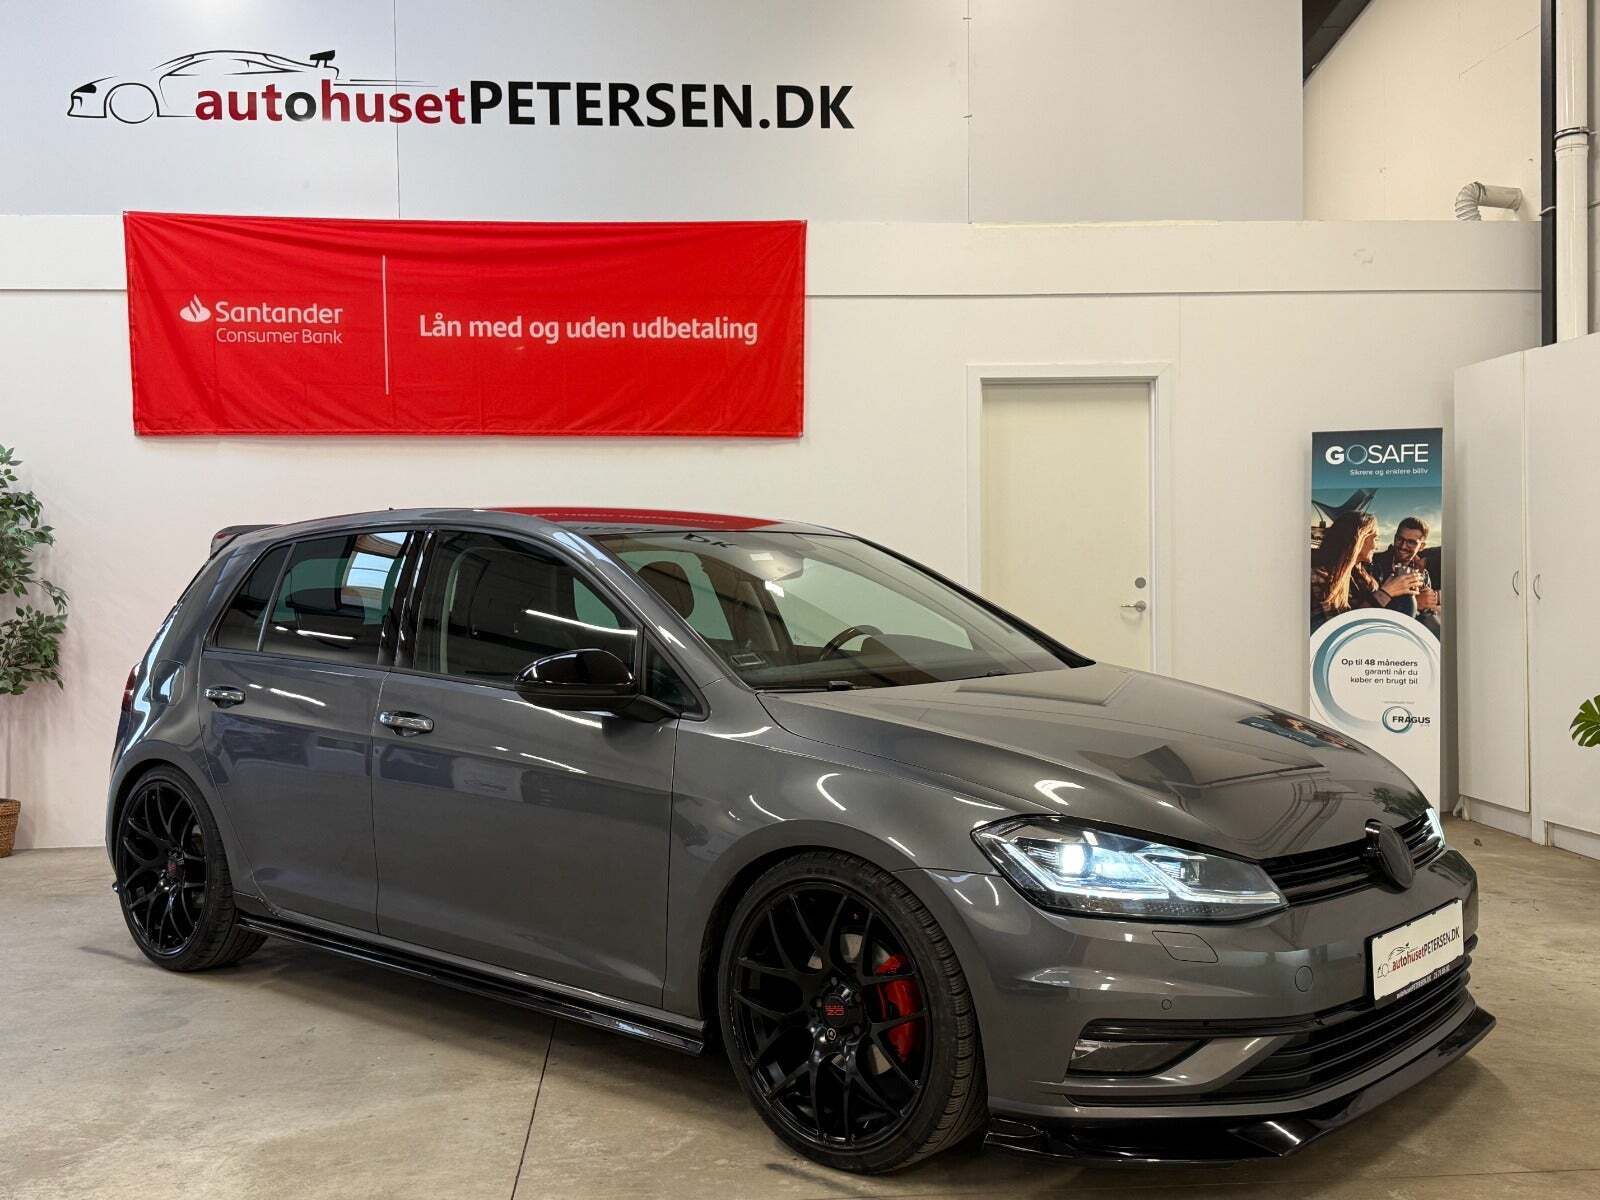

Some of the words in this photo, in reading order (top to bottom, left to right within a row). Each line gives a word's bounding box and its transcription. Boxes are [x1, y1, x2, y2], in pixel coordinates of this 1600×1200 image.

[195, 79, 855, 129] autohusetPETERSEN.DK
[215, 301, 343, 324] Santander
[216, 327, 299, 343] Consumer
[302, 328, 343, 344] Bank
[419, 312, 462, 337] Lån
[469, 315, 522, 337] med
[529, 320, 559, 344] og
[566, 316, 625, 338] uden
[632, 316, 758, 345] udbetaling
[1325, 443, 1429, 465] GOSAFE
[1341, 658, 1354, 666] Op
[1355, 658, 1363, 666] til
[1364, 658, 1376, 666] 48
[1377, 658, 1418, 667] måneders
[1364, 668, 1391, 676] garanti
[1393, 667, 1406, 676] når
[1407, 668, 1418, 676] du
[1386, 677, 1407, 686] brugt
[1408, 677, 1418, 685] bil
[1392, 715, 1431, 724] FRAGUS
[1392, 926, 1460, 972] autohusetPETERSEN.DK
